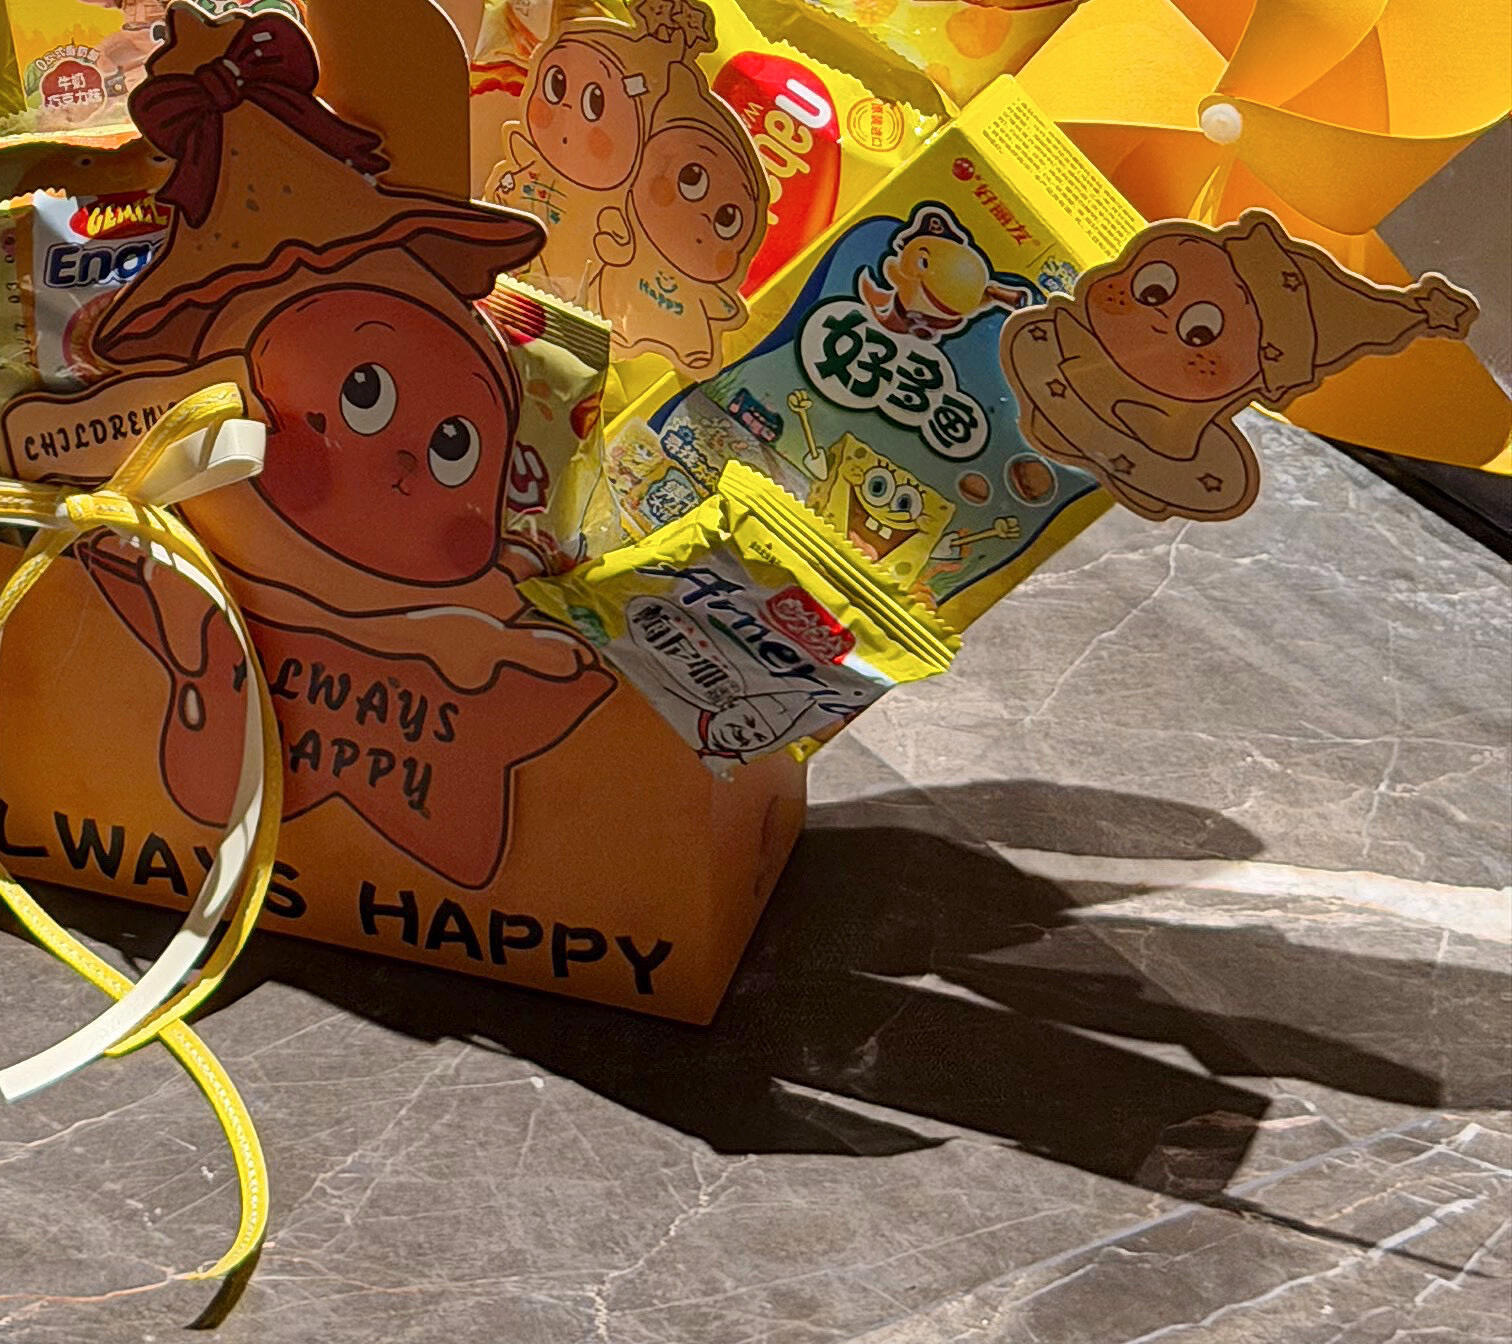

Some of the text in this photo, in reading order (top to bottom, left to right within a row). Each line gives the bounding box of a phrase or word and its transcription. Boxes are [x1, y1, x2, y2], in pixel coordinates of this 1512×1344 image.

[45, 240, 156, 289] Ena
[814, 309, 981, 449] 好多鱼
[276, 718, 433, 819] APPY
[359, 880, 675, 997] HAPPY
